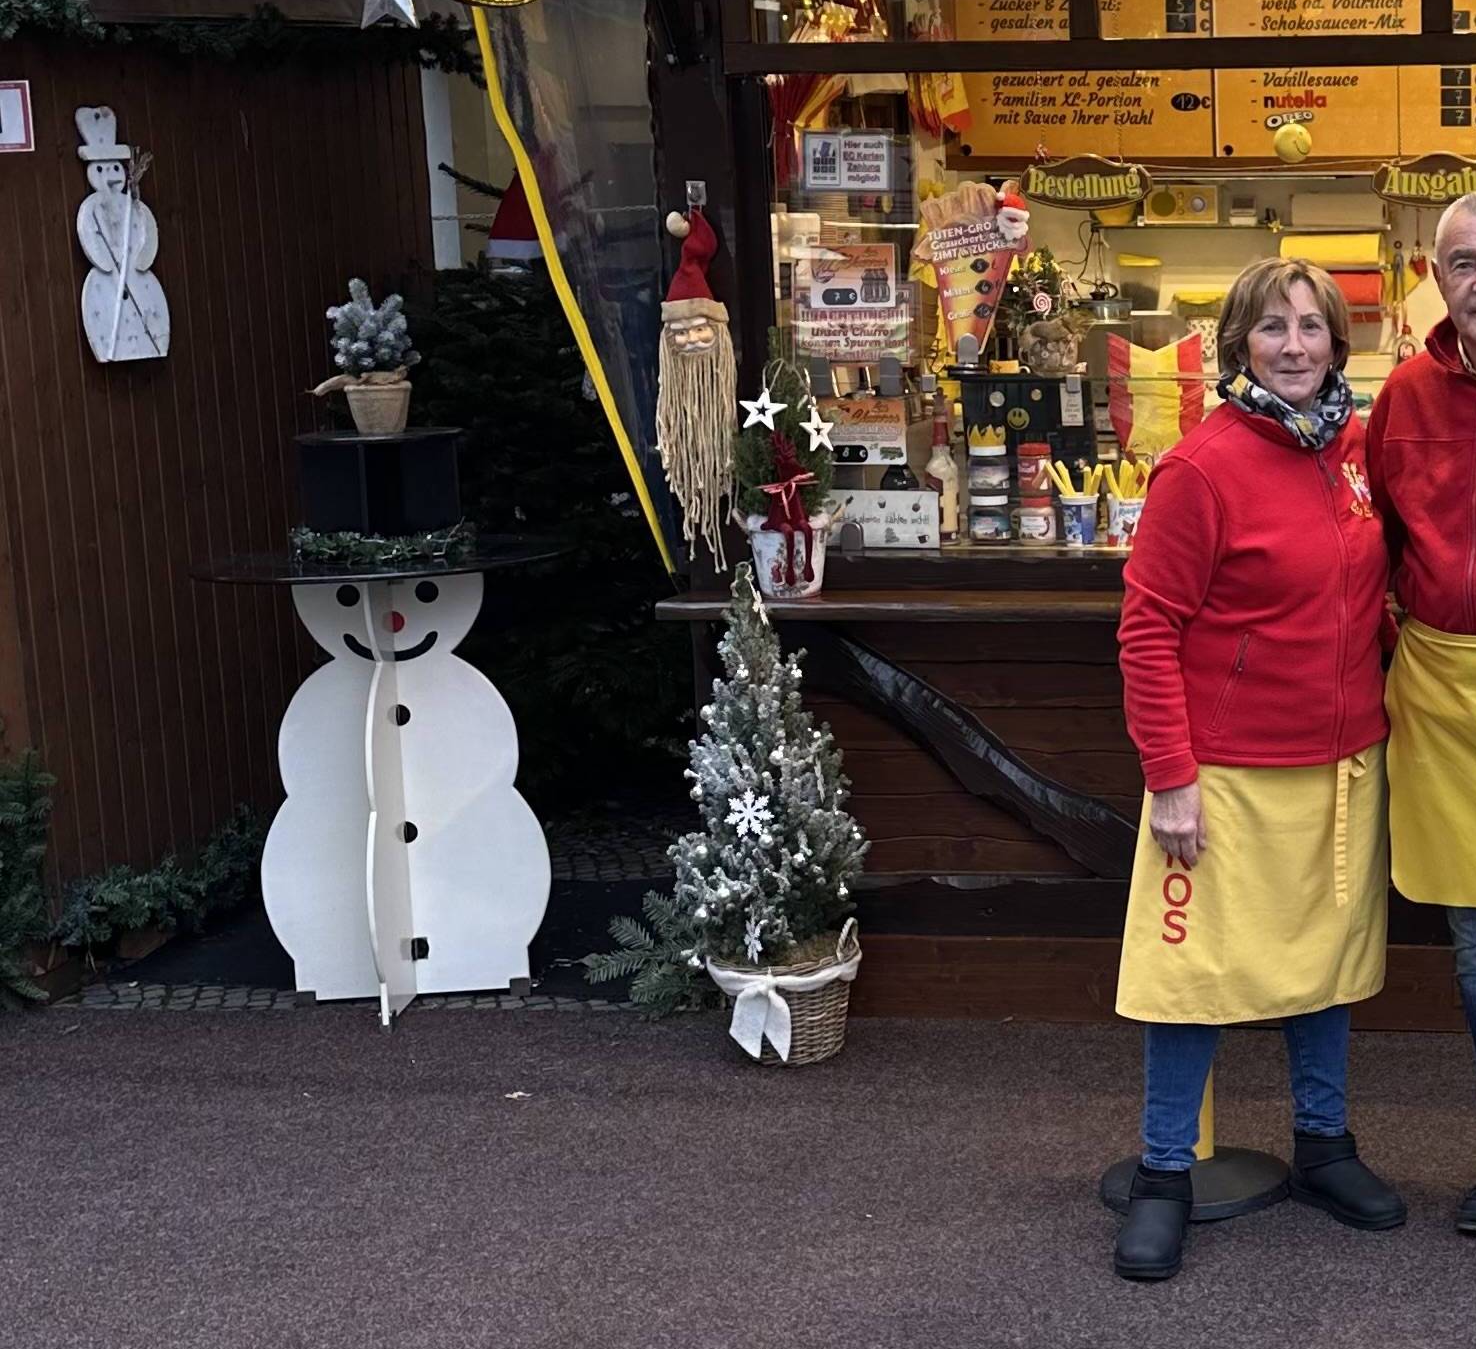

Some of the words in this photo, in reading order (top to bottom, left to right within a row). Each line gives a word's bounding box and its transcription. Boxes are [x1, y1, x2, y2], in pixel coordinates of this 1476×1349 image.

[990, 14, 1060, 30] gesalzen
[1261, 11, 1407, 31] Schokosaucen-Mix
[992, 72, 1065, 91] gezuckert
[1068, 70, 1091, 87] od.
[1096, 71, 1160, 92] gesalzen
[1263, 70, 1359, 88] Vanillesauce
[992, 91, 1057, 107] Familien
[1061, 92, 1142, 107] XL-Portion
[1174, 94, 1196, 110] 12
[1263, 90, 1328, 109] nutella
[993, 110, 1020, 126] mit
[1024, 109, 1066, 125] Sauce
[1071, 109, 1109, 126] Ihrer
[1114, 108, 1154, 125] Wahl
[1266, 110, 1314, 129] OREO
[1027, 169, 1143, 200] Bestellung
